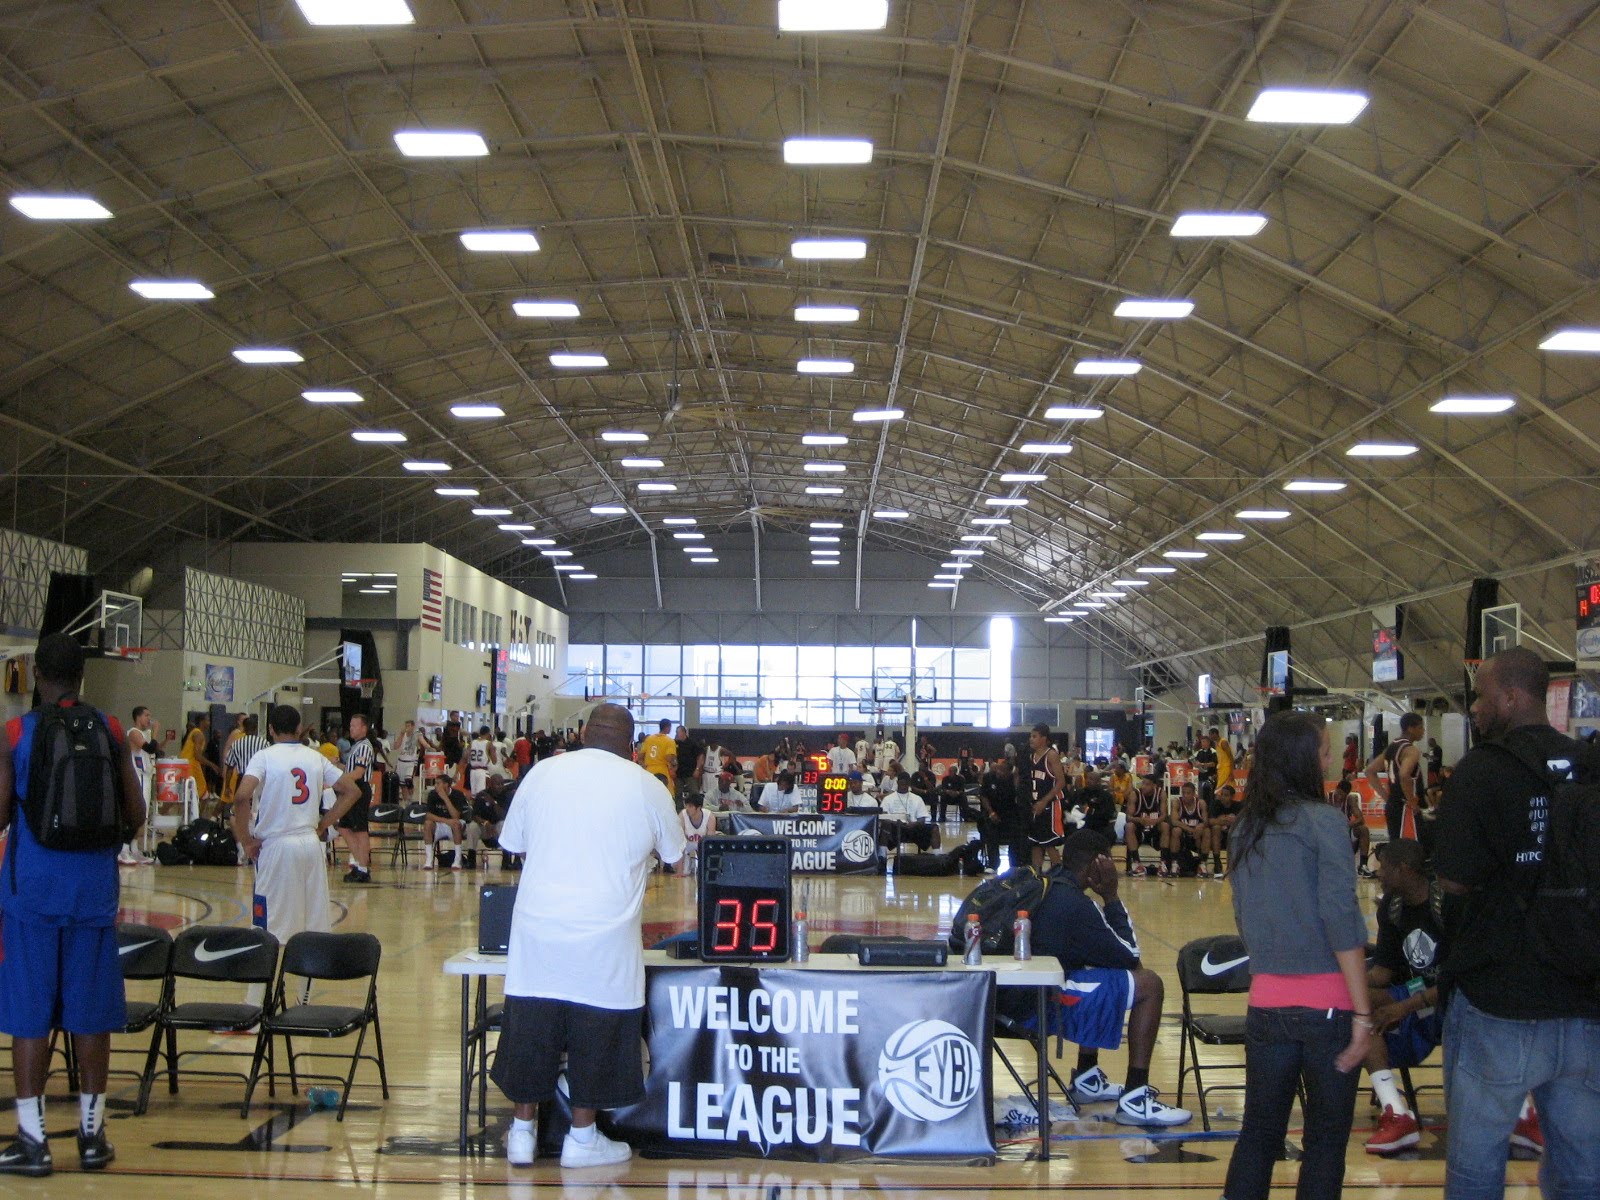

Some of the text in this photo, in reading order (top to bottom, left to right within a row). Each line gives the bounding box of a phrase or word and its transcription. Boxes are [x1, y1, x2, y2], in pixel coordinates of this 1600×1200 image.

[470, 749, 483, 762] 22
[650, 745, 658, 758] 5
[164, 770, 176, 784] G
[291, 767, 310, 805] 3
[803, 772, 819, 784] 33
[824, 777, 847, 790] 0:00
[822, 793, 844, 811] 35
[772, 820, 836, 836] WELCOME
[791, 838, 817, 848] TO THE
[853, 832, 873, 857] EYBL
[791, 851, 836, 870] AGUE
[713, 899, 777, 951] 35
[668, 985, 860, 1035] WELCOME
[725, 1043, 801, 1074] TO THE
[914, 1039, 976, 1102] EYBL
[667, 1081, 861, 1146] LEAGUE
